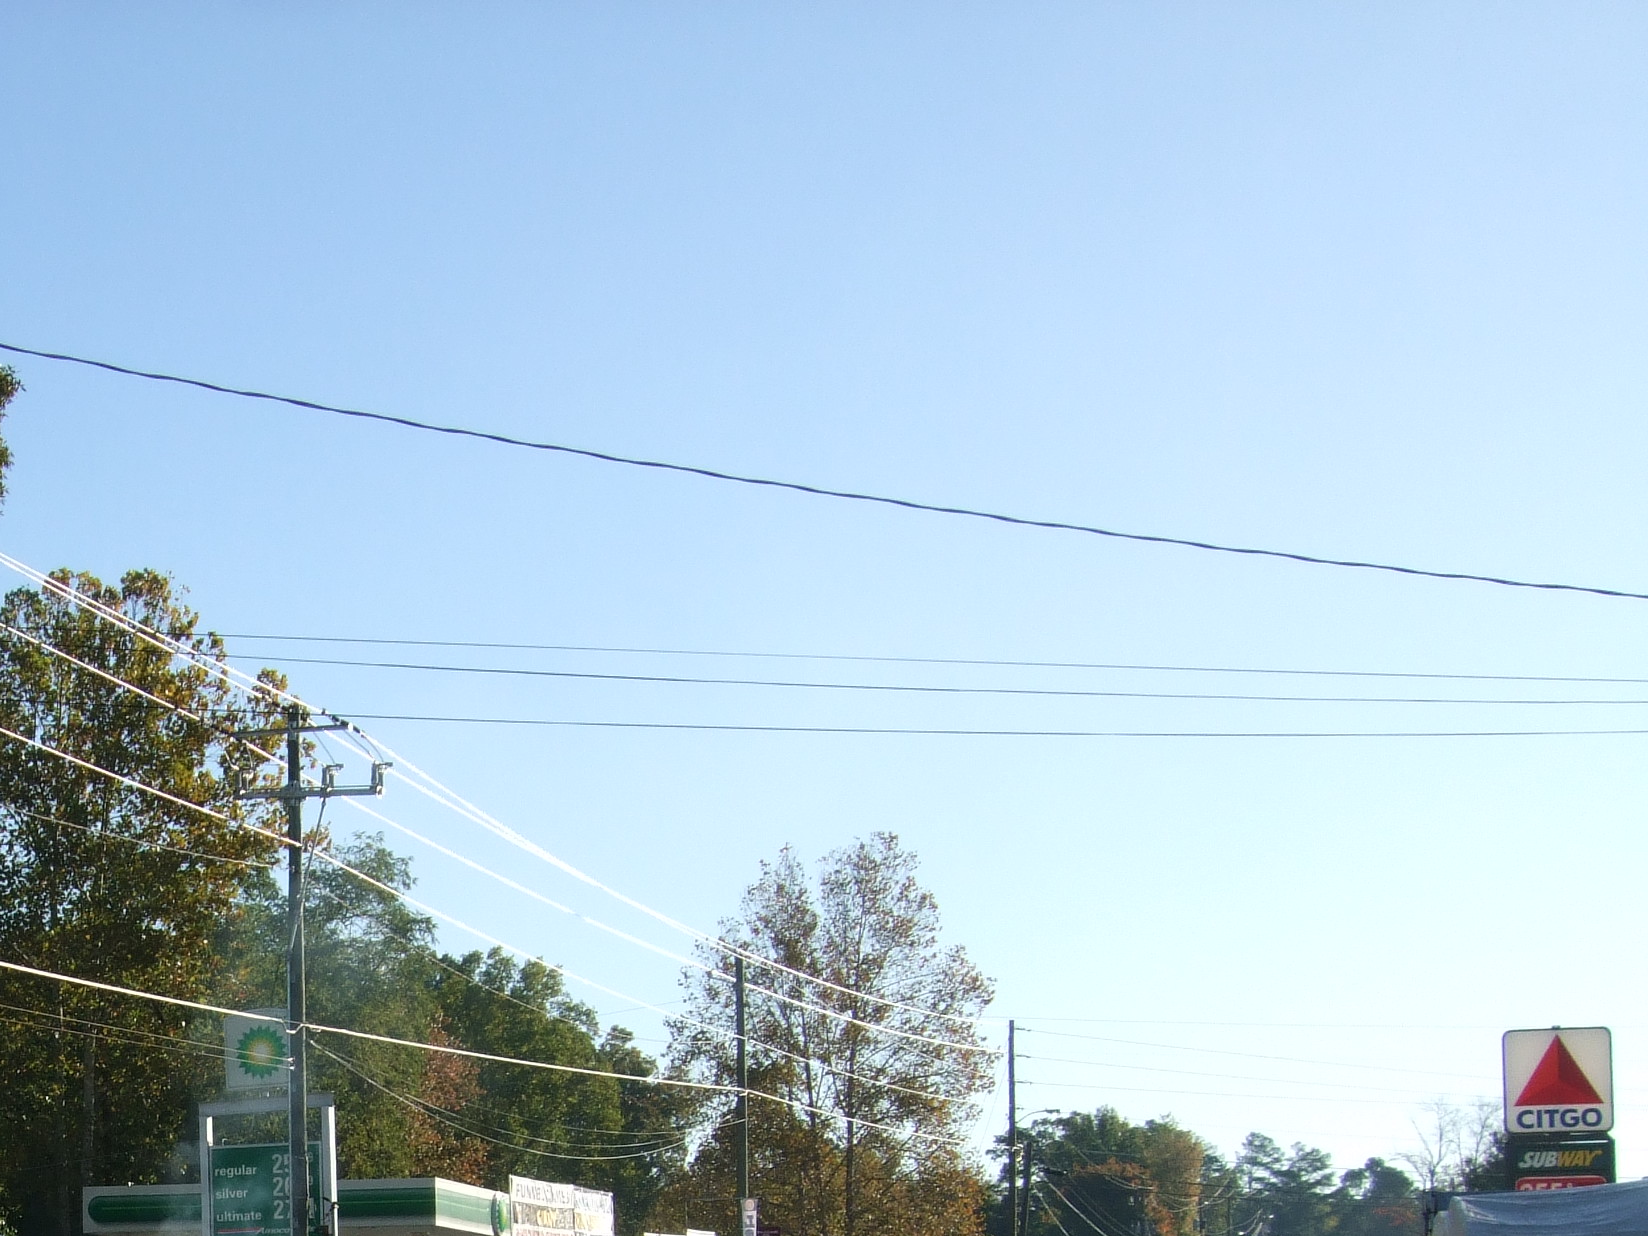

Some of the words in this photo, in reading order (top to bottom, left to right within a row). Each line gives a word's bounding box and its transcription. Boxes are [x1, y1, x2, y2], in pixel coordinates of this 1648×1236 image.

[1516, 1108, 1602, 1129] CITGO
[1518, 1151, 1601, 1168] SUBWAY
[214, 1165, 257, 1178] regular
[215, 1188, 248, 1200] silver
[216, 1211, 262, 1222] ultimate
